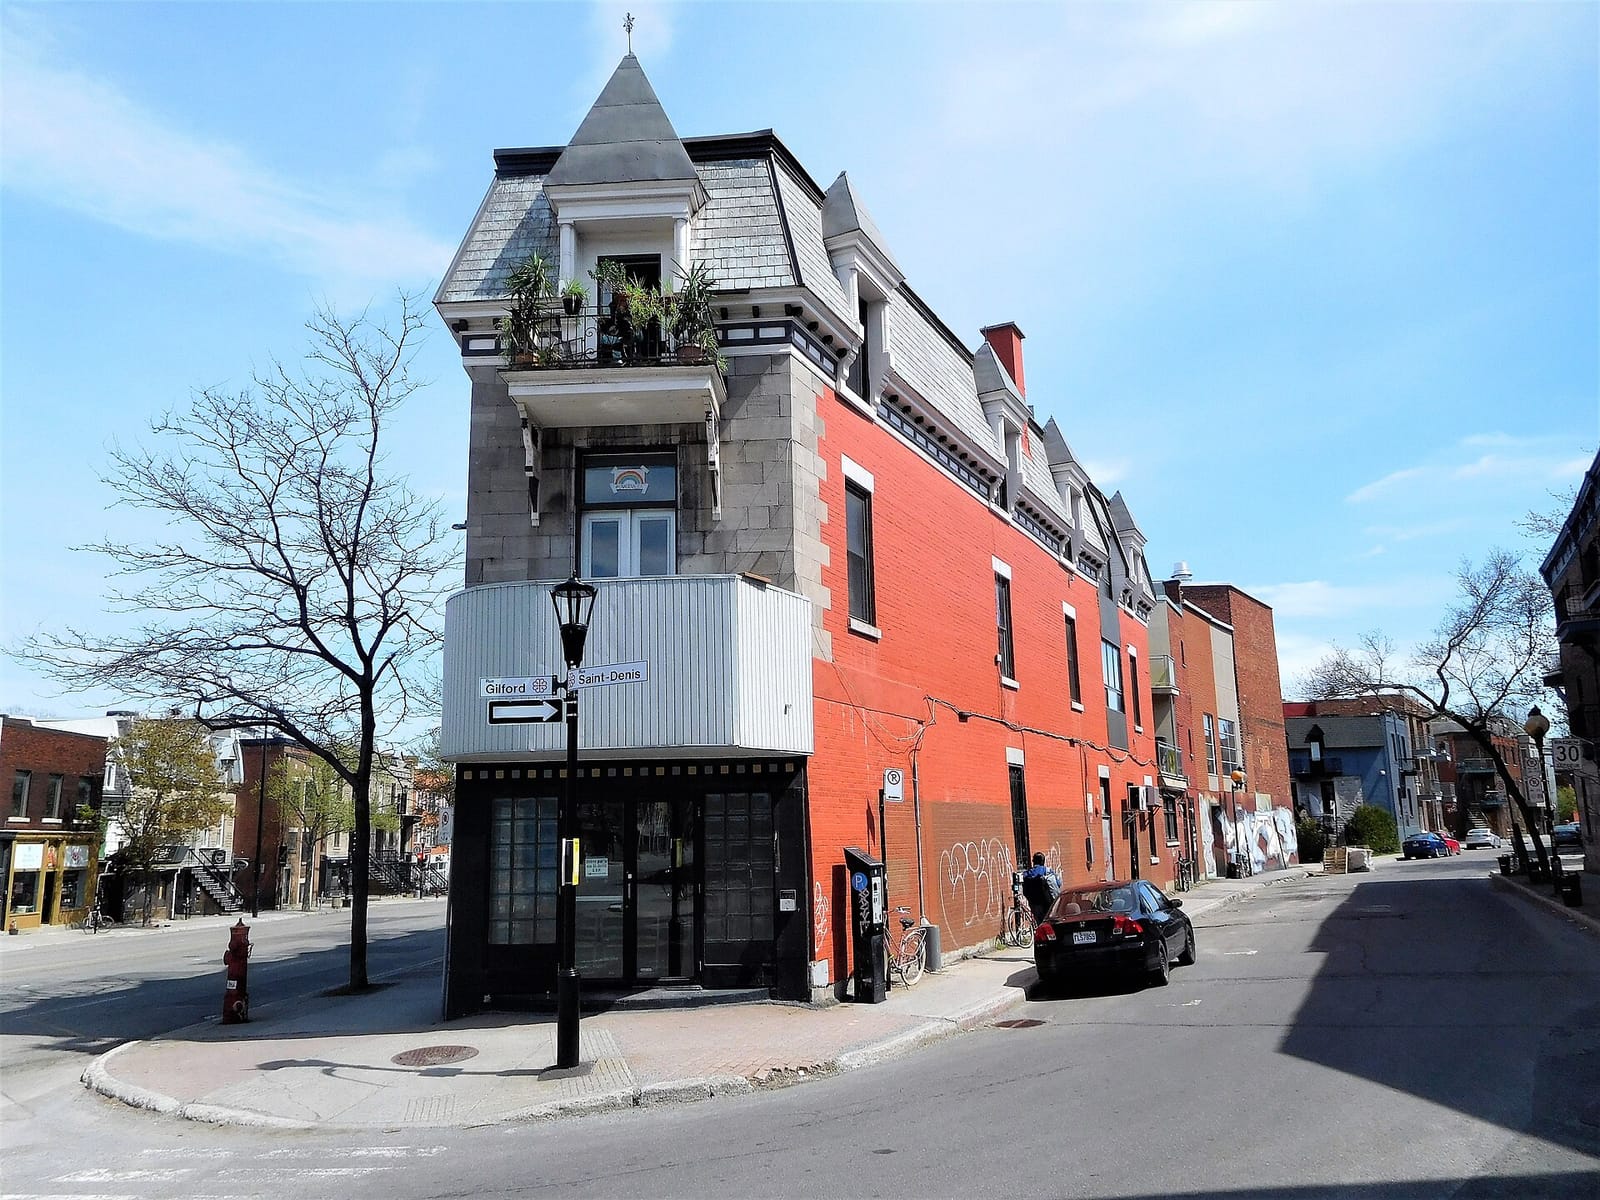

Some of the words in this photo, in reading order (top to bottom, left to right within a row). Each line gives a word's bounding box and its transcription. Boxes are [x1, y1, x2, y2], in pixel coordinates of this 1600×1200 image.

[579, 669, 640, 685] Saint-Denis
[486, 683, 525, 694] Gilford
[1556, 745, 1579, 762] 30
